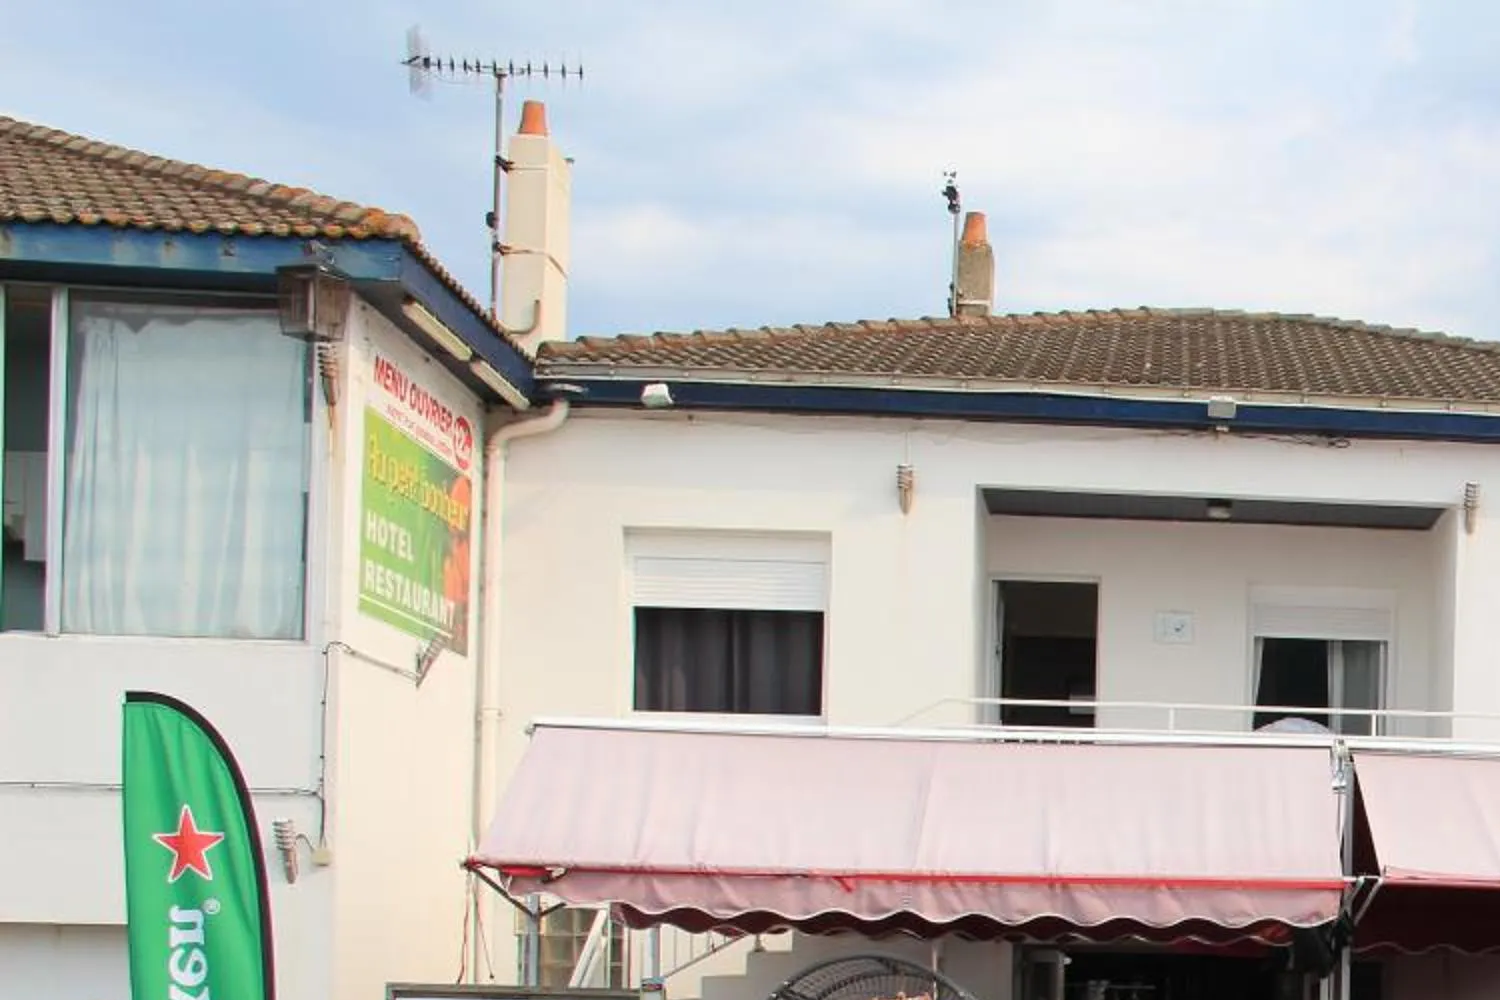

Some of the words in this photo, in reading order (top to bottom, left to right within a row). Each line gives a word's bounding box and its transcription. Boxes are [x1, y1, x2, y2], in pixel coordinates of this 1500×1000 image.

[374, 354, 409, 402] MENU
[365, 508, 413, 563] HOTEL
[364, 556, 455, 629] RESTAURANT
